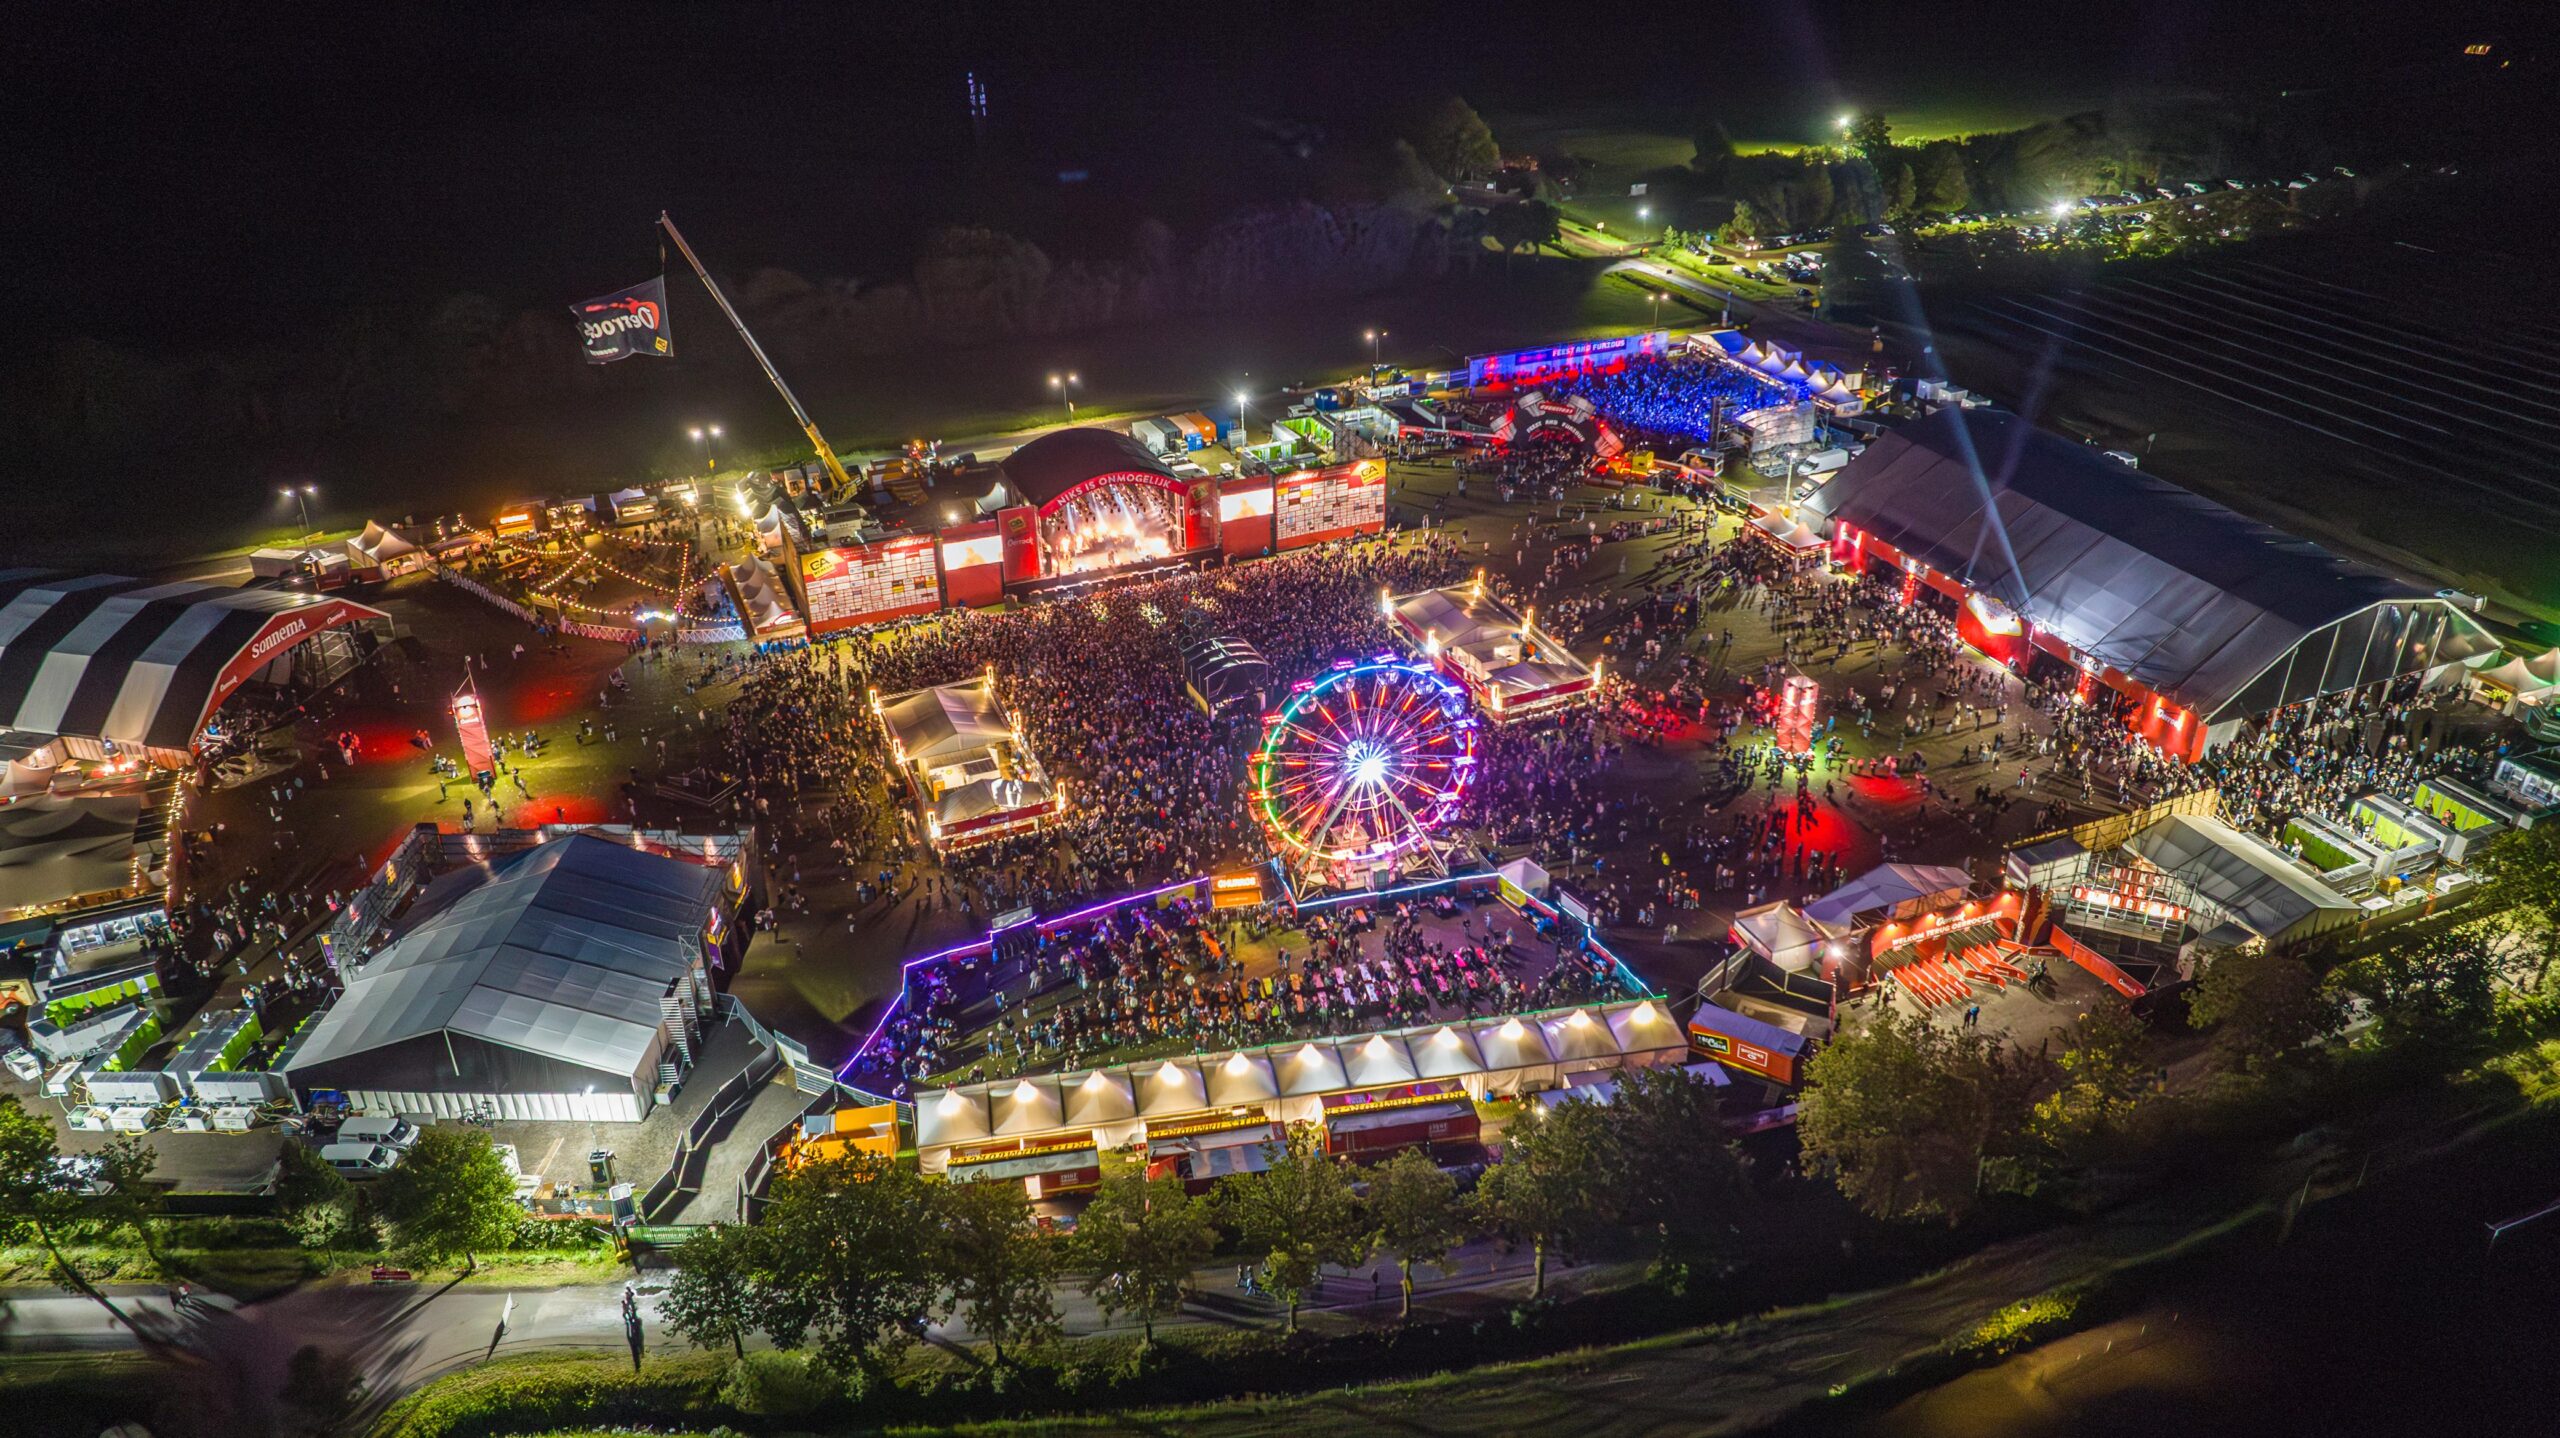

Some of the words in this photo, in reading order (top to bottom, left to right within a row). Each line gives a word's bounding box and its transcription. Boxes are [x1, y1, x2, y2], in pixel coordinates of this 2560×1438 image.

[1057, 486, 1083, 507] NIKS
[1084, 480, 1096, 491] IS
[1098, 473, 1172, 489] ONMOGELIJK
[2124, 883, 2144, 898] IS
